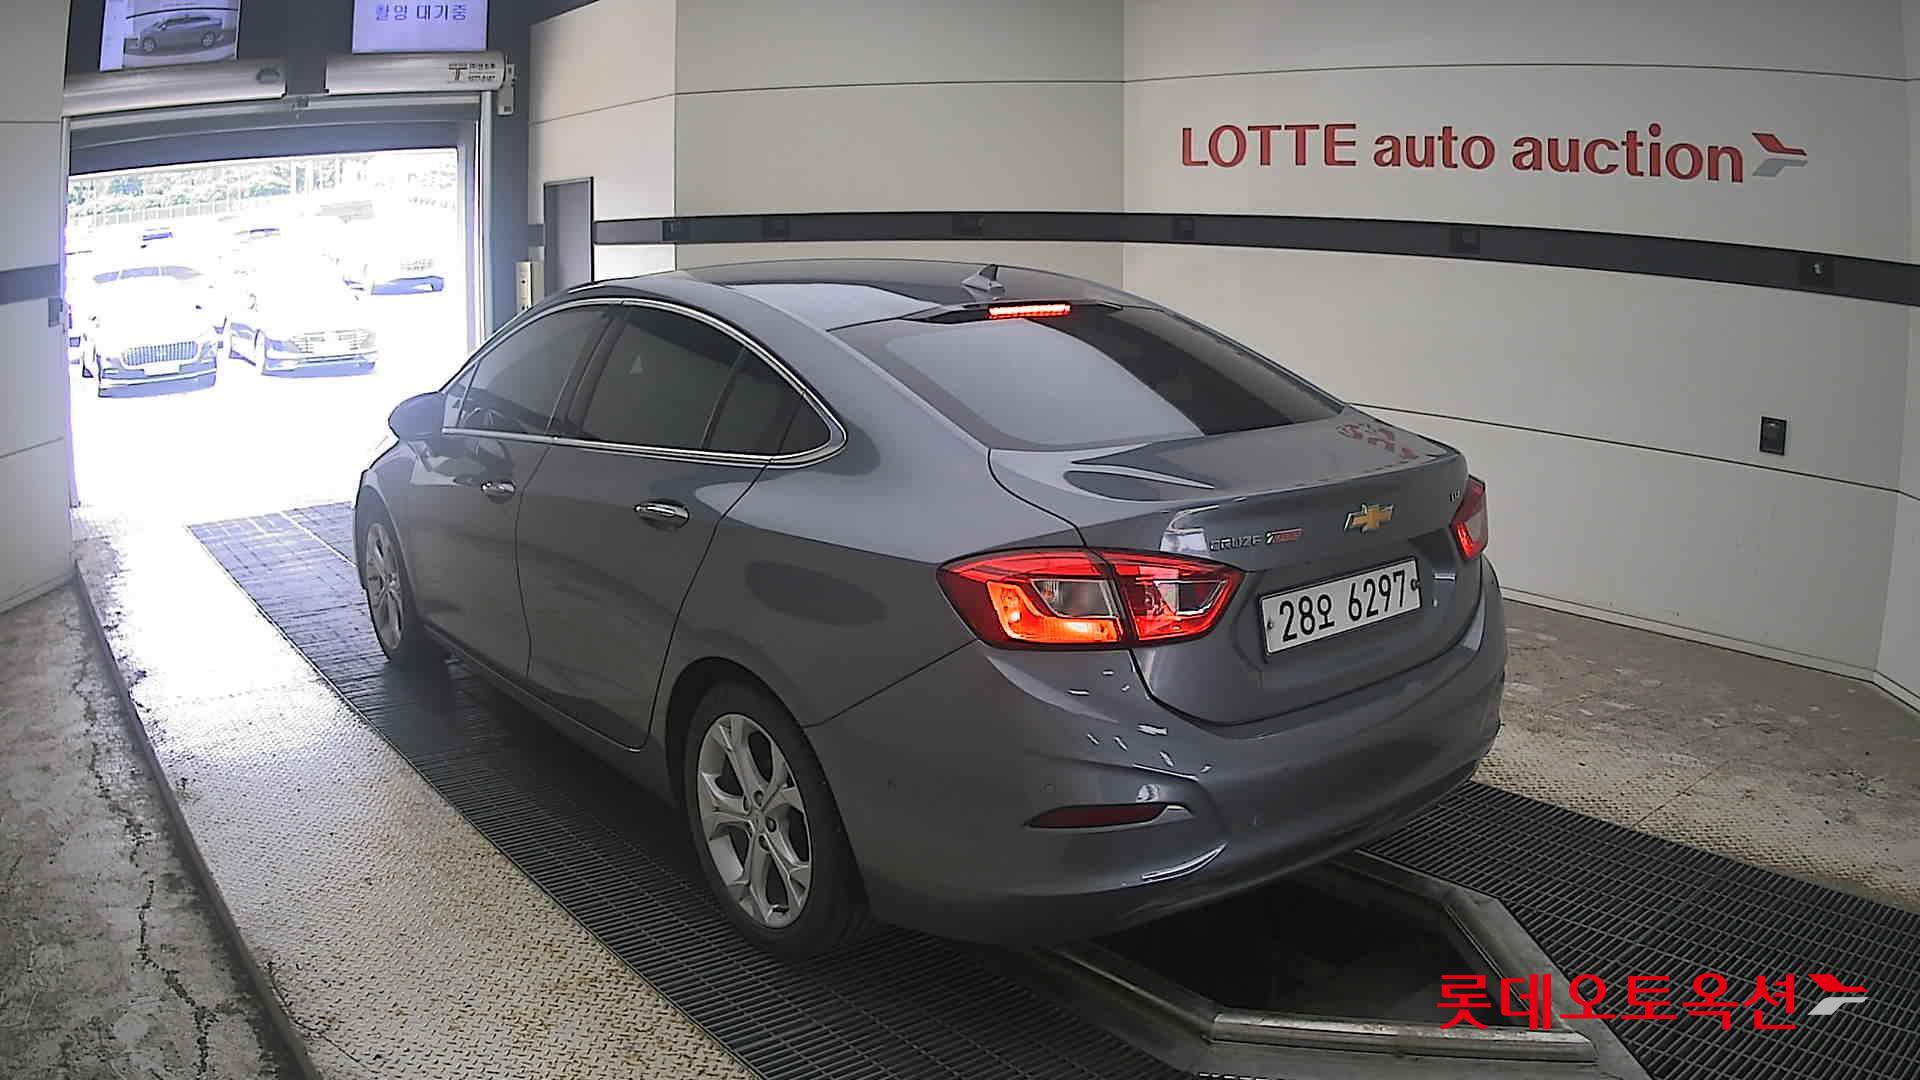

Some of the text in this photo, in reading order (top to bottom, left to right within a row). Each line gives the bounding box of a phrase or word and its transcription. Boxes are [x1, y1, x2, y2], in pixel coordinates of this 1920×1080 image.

[416, 4, 467, 21] 대기중
[1182, 122, 1744, 183] LOTTE auto auction
[1279, 569, 1405, 642] 28오 6297
